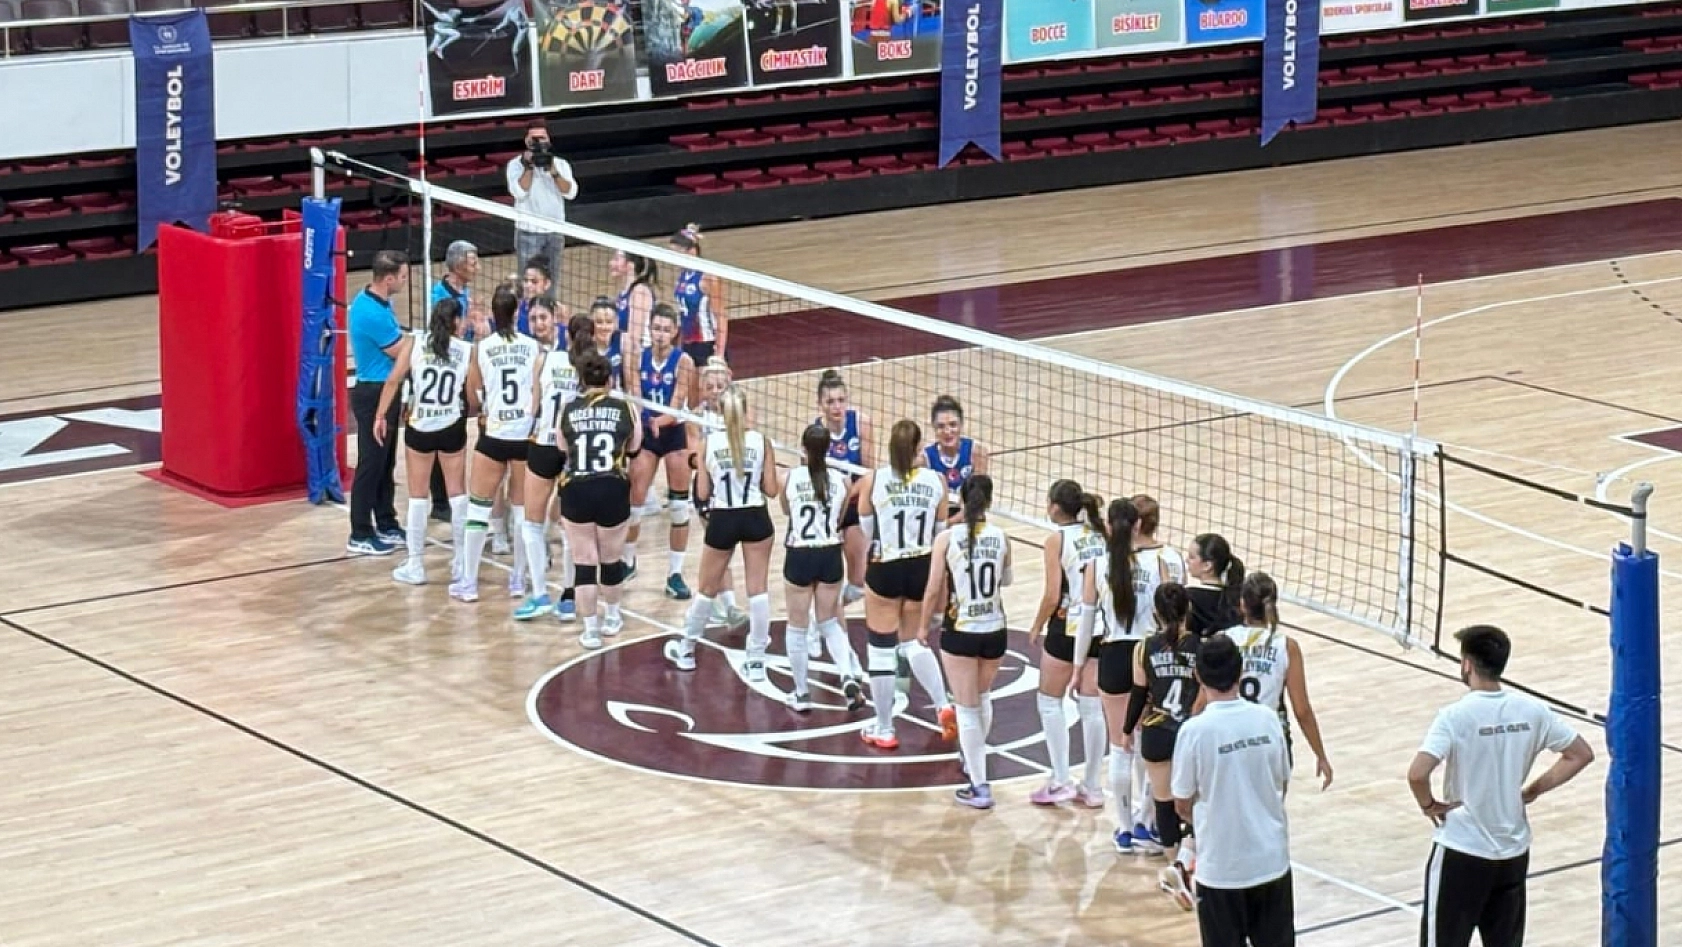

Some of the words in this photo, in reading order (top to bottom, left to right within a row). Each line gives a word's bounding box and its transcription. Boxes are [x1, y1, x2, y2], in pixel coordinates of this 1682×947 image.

[1031, 24, 1066, 43] BOCCE
[1200, 9, 1247, 29] BİLARDO
[761, 45, 828, 71] CİMNASTİK
[878, 40, 912, 60] BOKS
[964, 3, 980, 110] VOLEYBOL
[1283, 0, 1298, 91] VOLEYBO
[454, 75, 505, 100] ESKRİM
[570, 70, 605, 90] DART
[667, 58, 727, 82] DAĞCILIK
[166, 65, 182, 185] VOLEYBOL
[420, 366, 457, 406] 20
[502, 368, 519, 405] 5
[551, 391, 562, 428] 1
[575, 433, 615, 472] 13
[720, 471, 753, 507] 17
[800, 504, 831, 540] 21
[893, 510, 927, 549] 11
[965, 562, 996, 600] 10
[1162, 679, 1182, 713] 4
